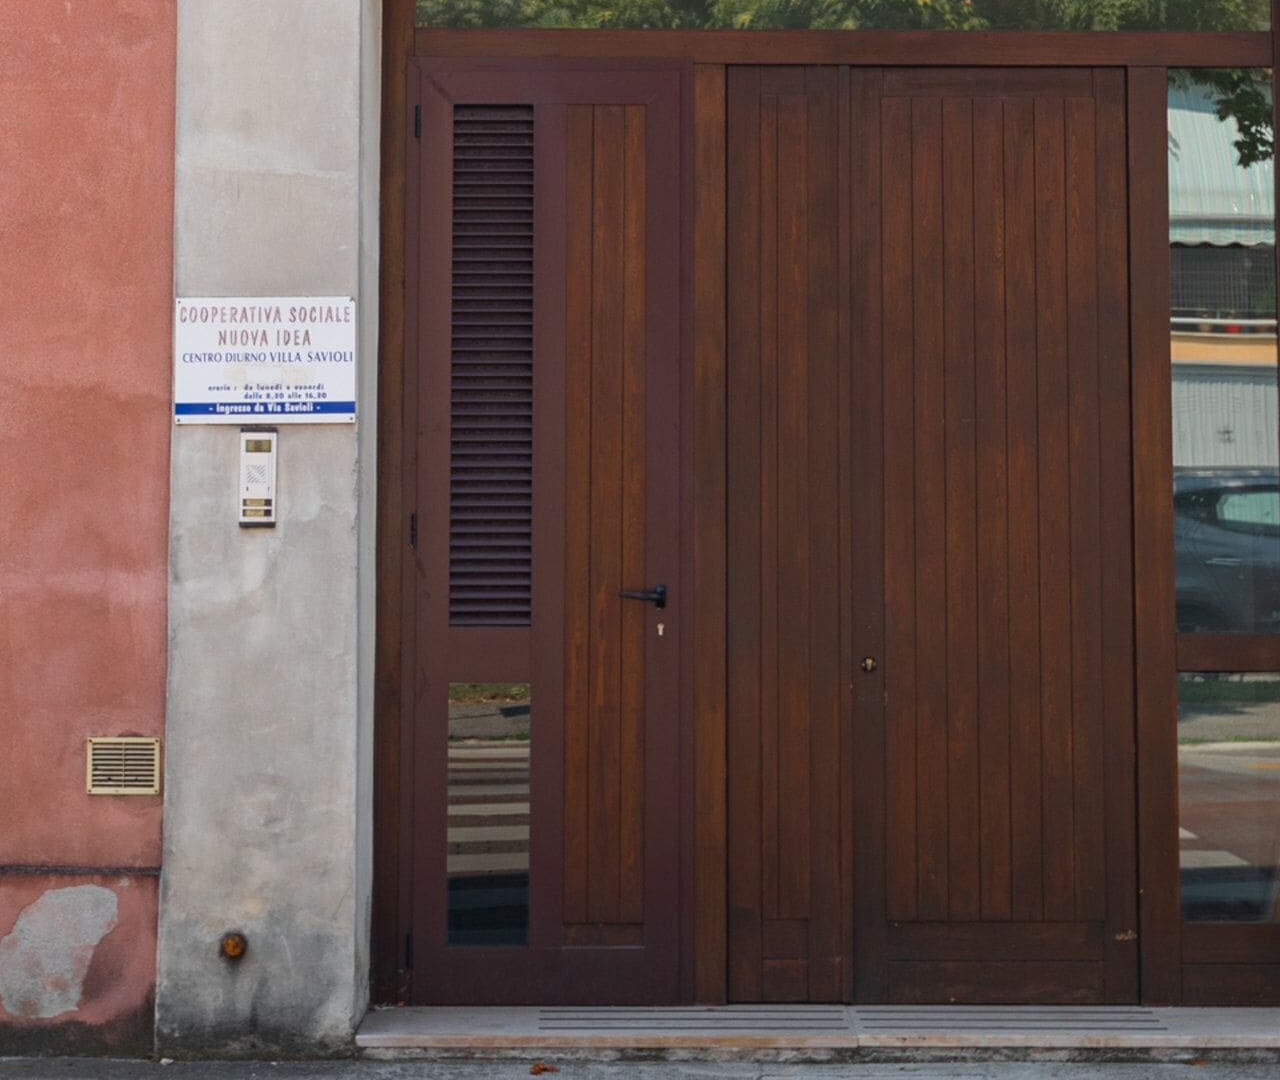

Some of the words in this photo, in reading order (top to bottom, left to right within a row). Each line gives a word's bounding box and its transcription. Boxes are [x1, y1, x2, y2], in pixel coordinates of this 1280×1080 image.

[180, 306, 282, 324] COOPERATIVA
[288, 305, 351, 324] SOCIALE
[218, 329, 269, 347] NUOVA
[276, 328, 312, 346] IDEA
[182, 351, 222, 363] CENTRO
[225, 351, 267, 363] DIURNO
[269, 351, 302, 363] VILLA
[306, 350, 353, 363] SAVIOLI
